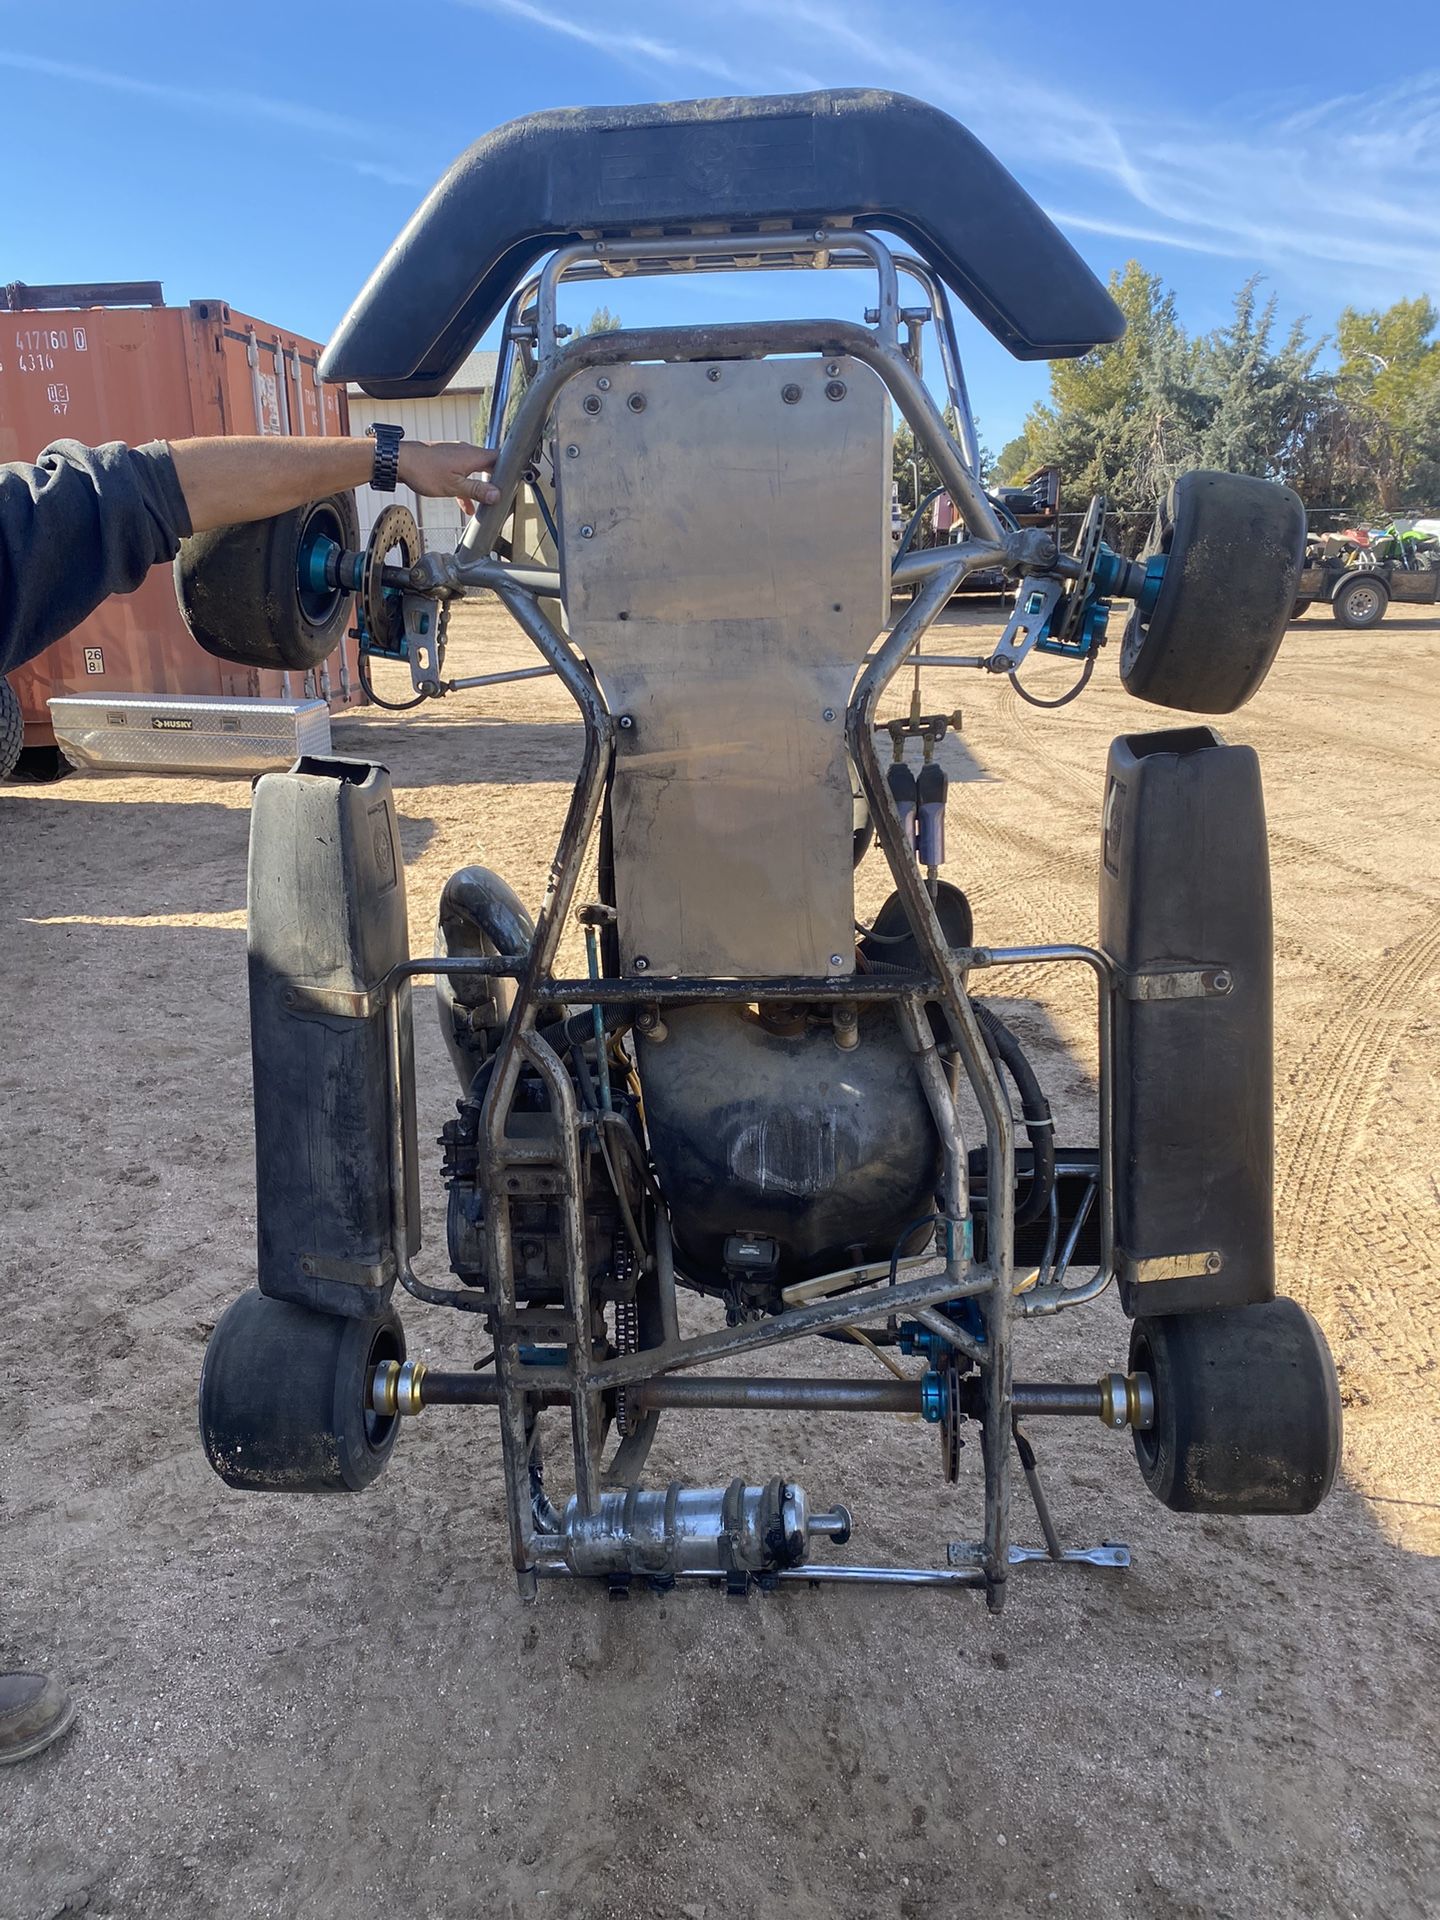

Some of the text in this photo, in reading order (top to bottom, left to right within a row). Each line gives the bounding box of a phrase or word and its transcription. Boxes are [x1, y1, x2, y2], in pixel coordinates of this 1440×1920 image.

[16, 330, 68, 350] 417160
[53, 403, 67, 415] 87
[87, 650, 101, 660] 26
[163, 720, 192, 728] HUSKY
